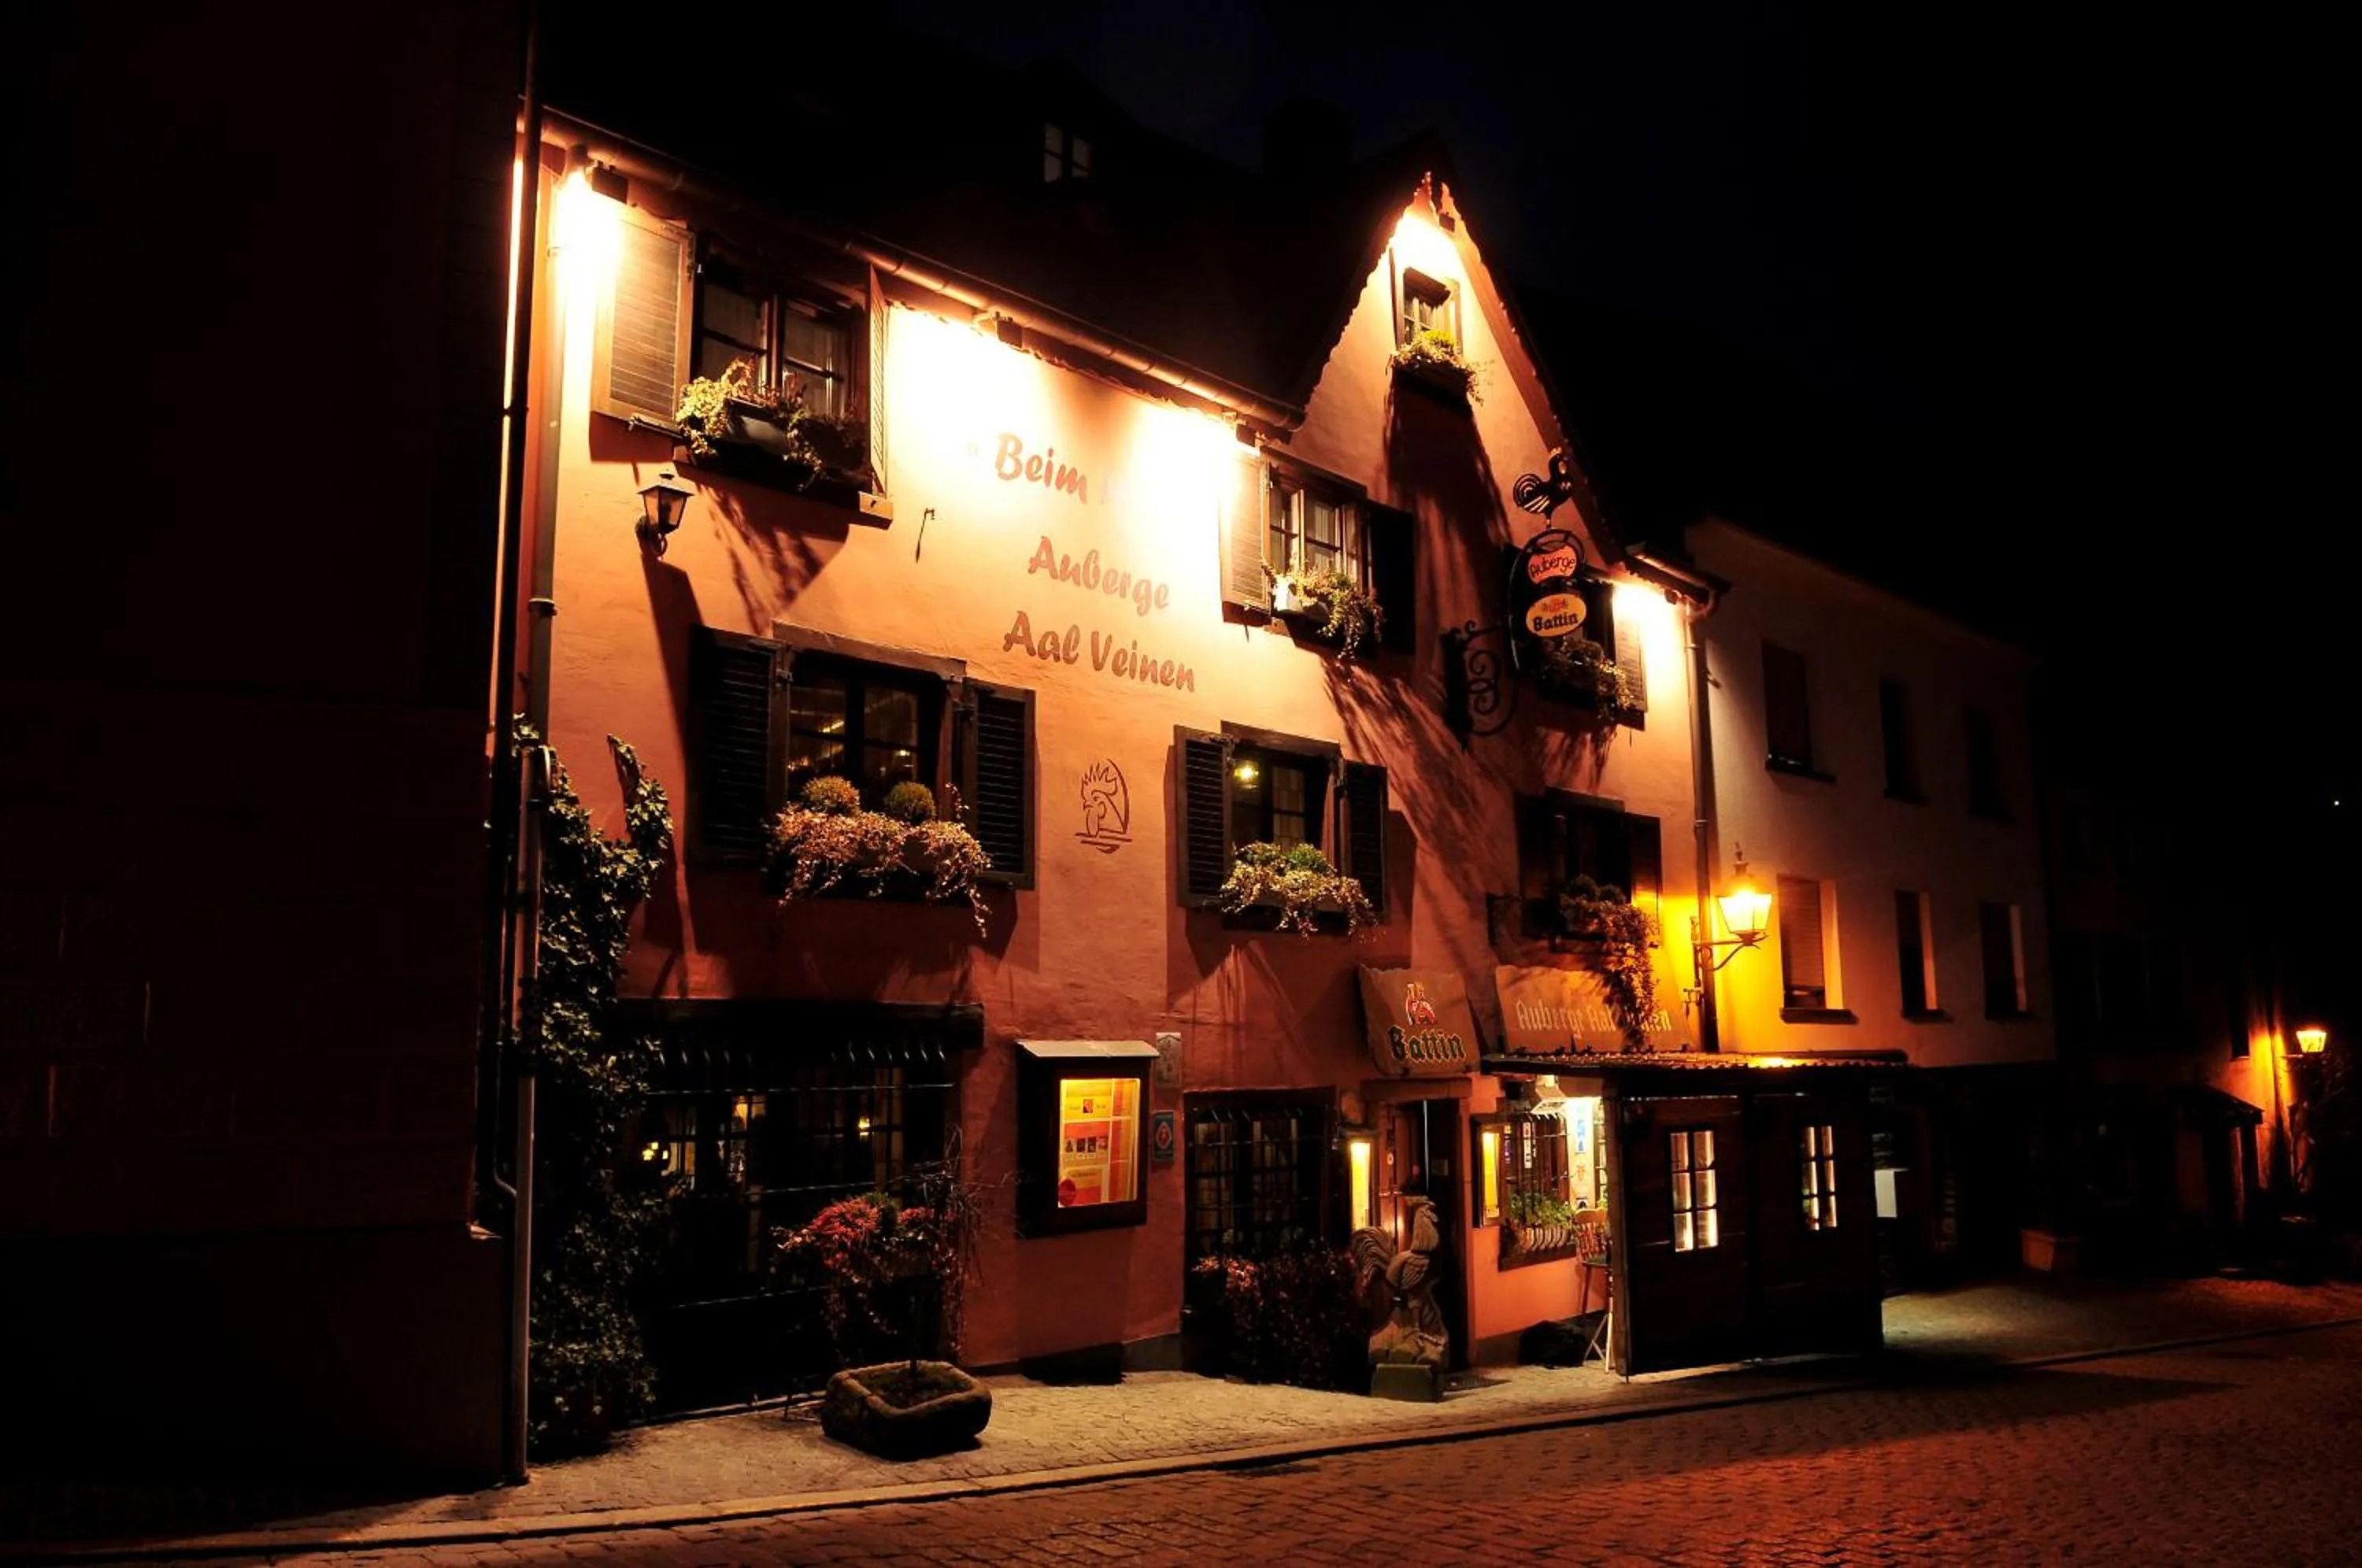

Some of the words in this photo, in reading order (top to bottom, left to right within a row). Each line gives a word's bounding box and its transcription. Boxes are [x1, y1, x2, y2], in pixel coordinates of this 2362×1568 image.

[994, 433, 1087, 505] Beim
[1027, 535, 1169, 616] Auberge
[1531, 557, 1575, 577] Auberge
[1534, 612, 1578, 631] Battin
[1002, 611, 1080, 664] Aal
[1090, 631, 1195, 693] Veinen
[1387, 1024, 1466, 1063] Battin
